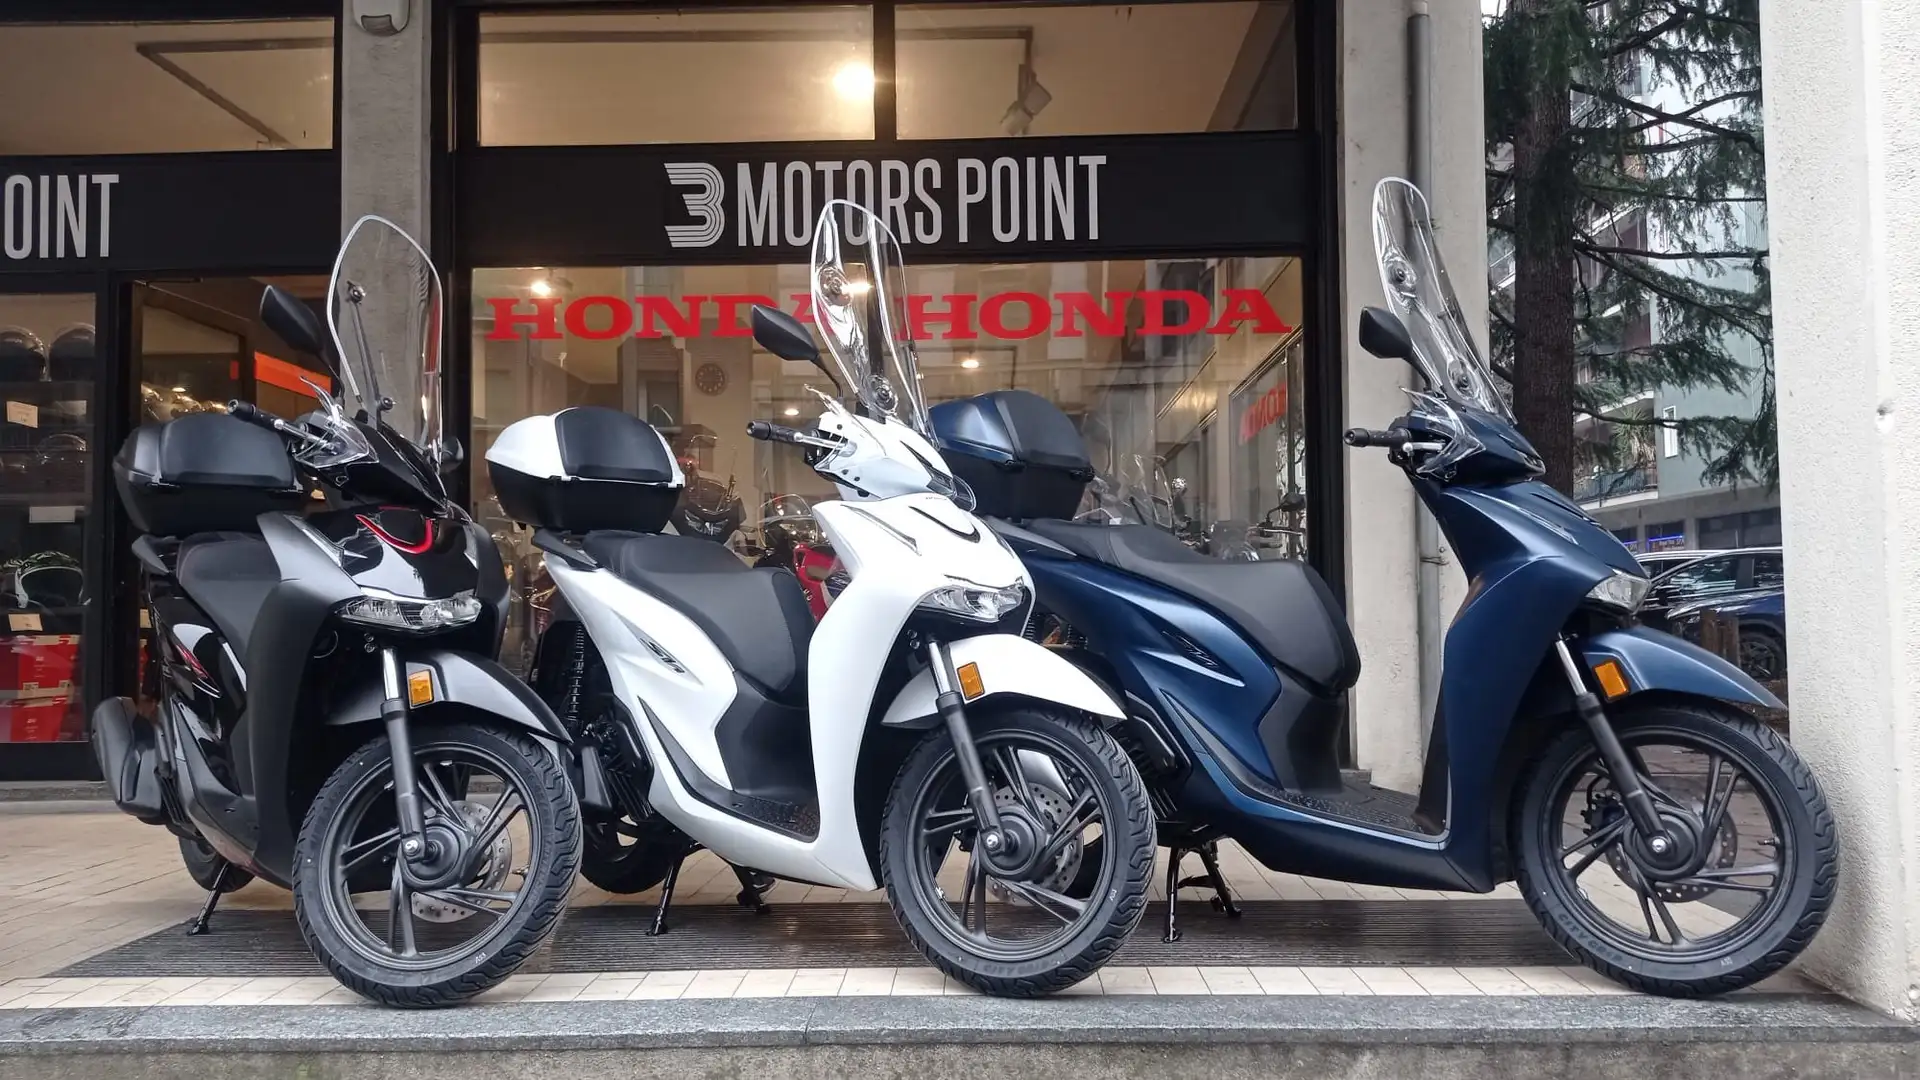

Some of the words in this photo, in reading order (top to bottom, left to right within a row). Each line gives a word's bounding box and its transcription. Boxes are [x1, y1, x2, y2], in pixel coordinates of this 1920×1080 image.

[4, 174, 120, 260] OINT
[737, 159, 942, 246] MOTORS
[957, 155, 1107, 243] POINT
[894, 288, 1292, 341] HONDA
